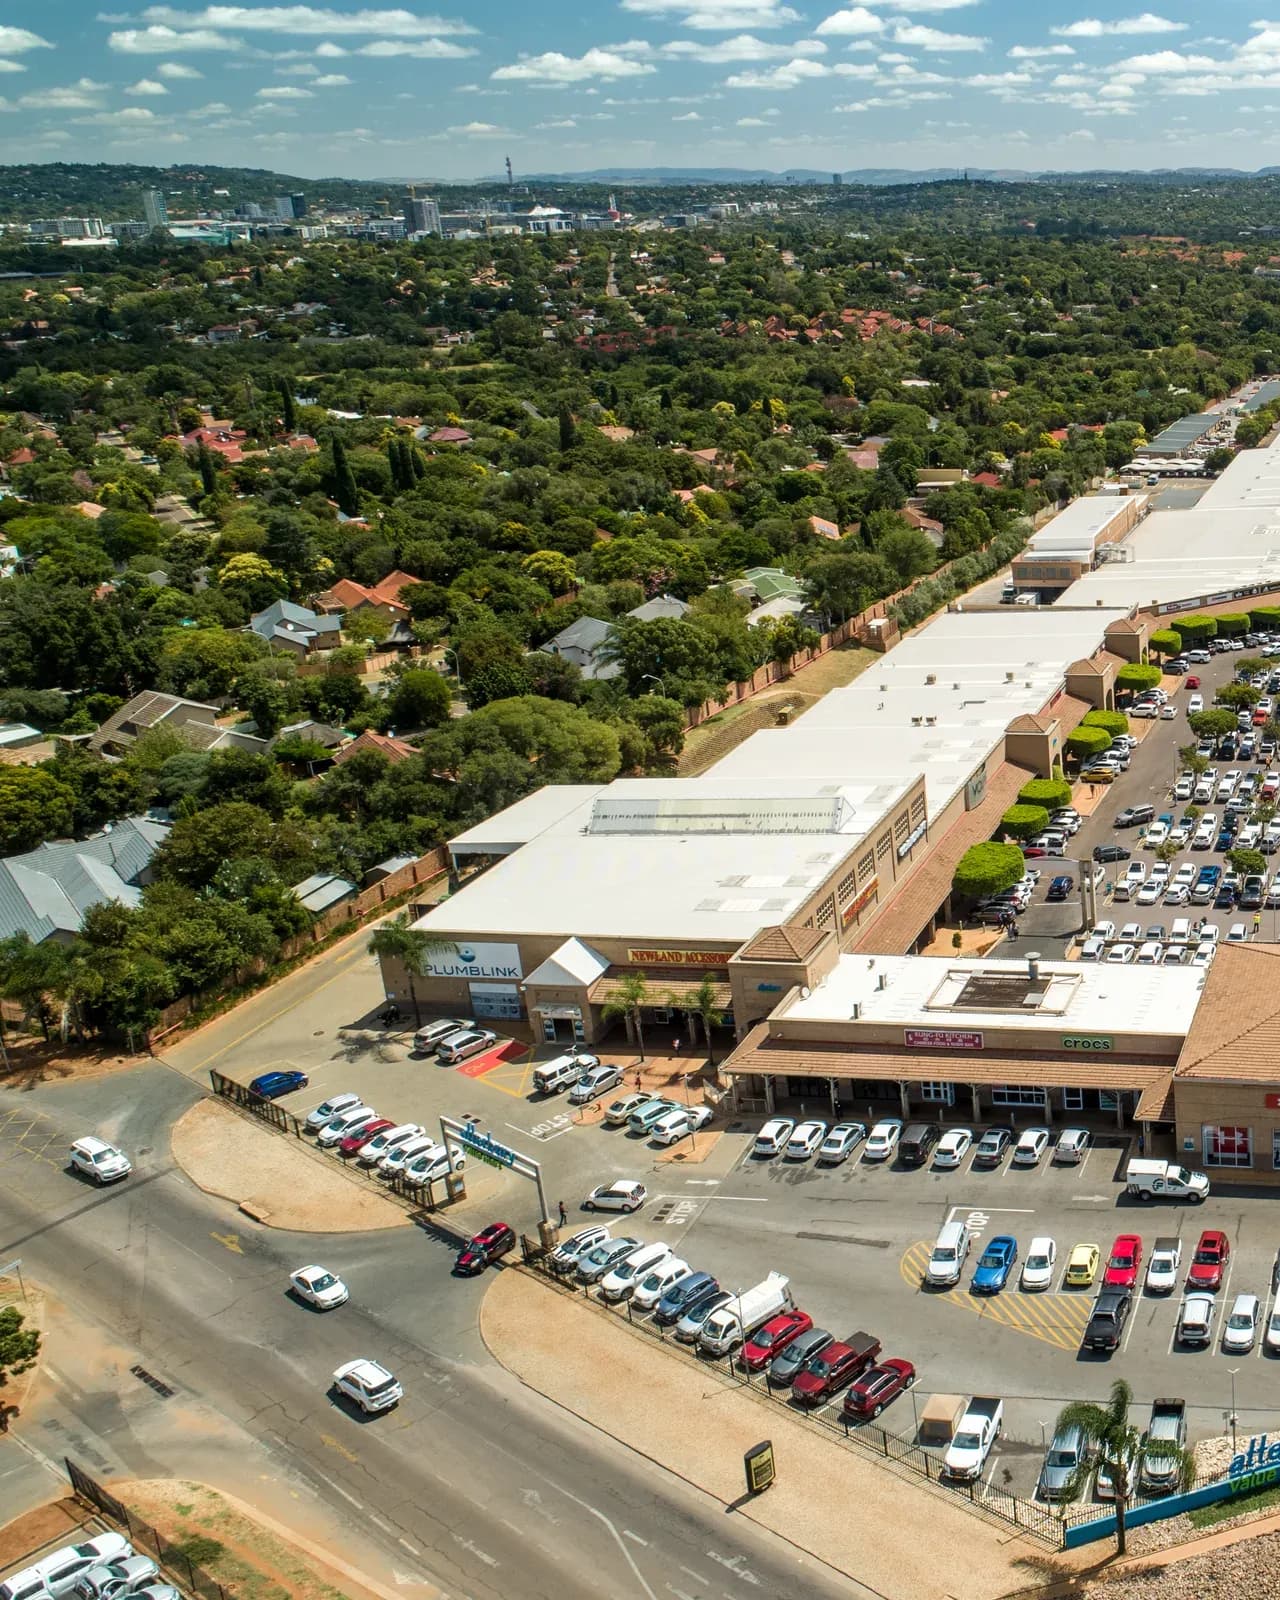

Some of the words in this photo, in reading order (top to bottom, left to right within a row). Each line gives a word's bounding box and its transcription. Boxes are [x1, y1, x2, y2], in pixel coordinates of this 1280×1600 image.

[631, 950, 682, 962] NEWLAND
[424, 964, 519, 977] PLUMBLINK
[1063, 1038, 1110, 1049] crocs
[530, 1114, 569, 1136] STOP
[666, 1201, 699, 1224] STOP
[965, 1211, 990, 1239] STOP
[1230, 1466, 1277, 1493] value
